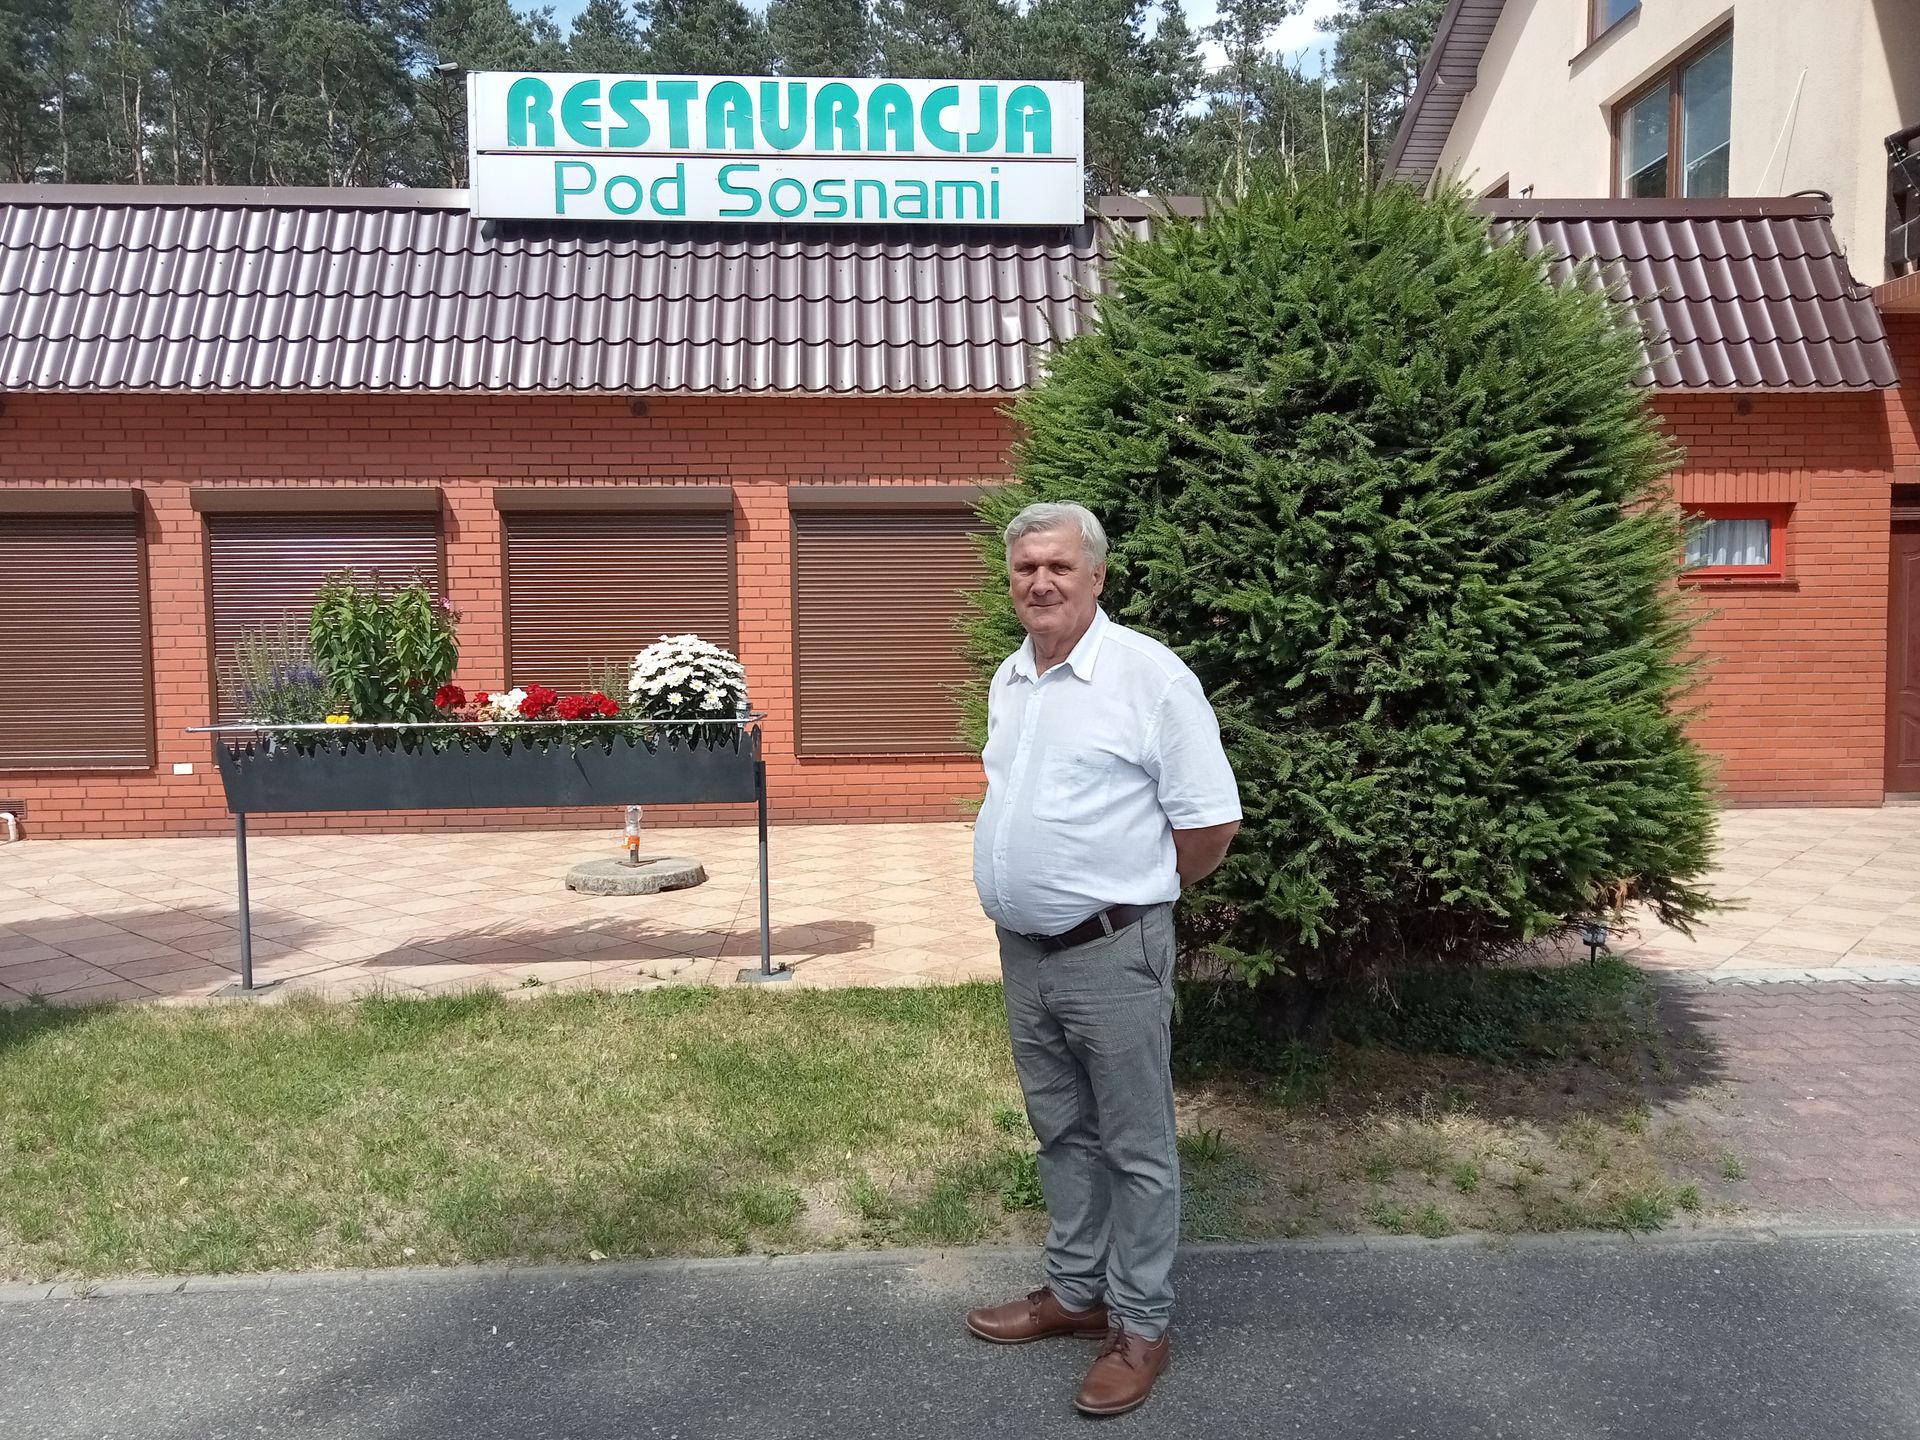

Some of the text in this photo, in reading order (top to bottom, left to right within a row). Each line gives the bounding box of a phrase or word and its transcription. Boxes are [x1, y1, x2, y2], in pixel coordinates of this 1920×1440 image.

[508, 78, 1051, 153] RESTAURACJA
[555, 161, 999, 219] Pod Sosnami
